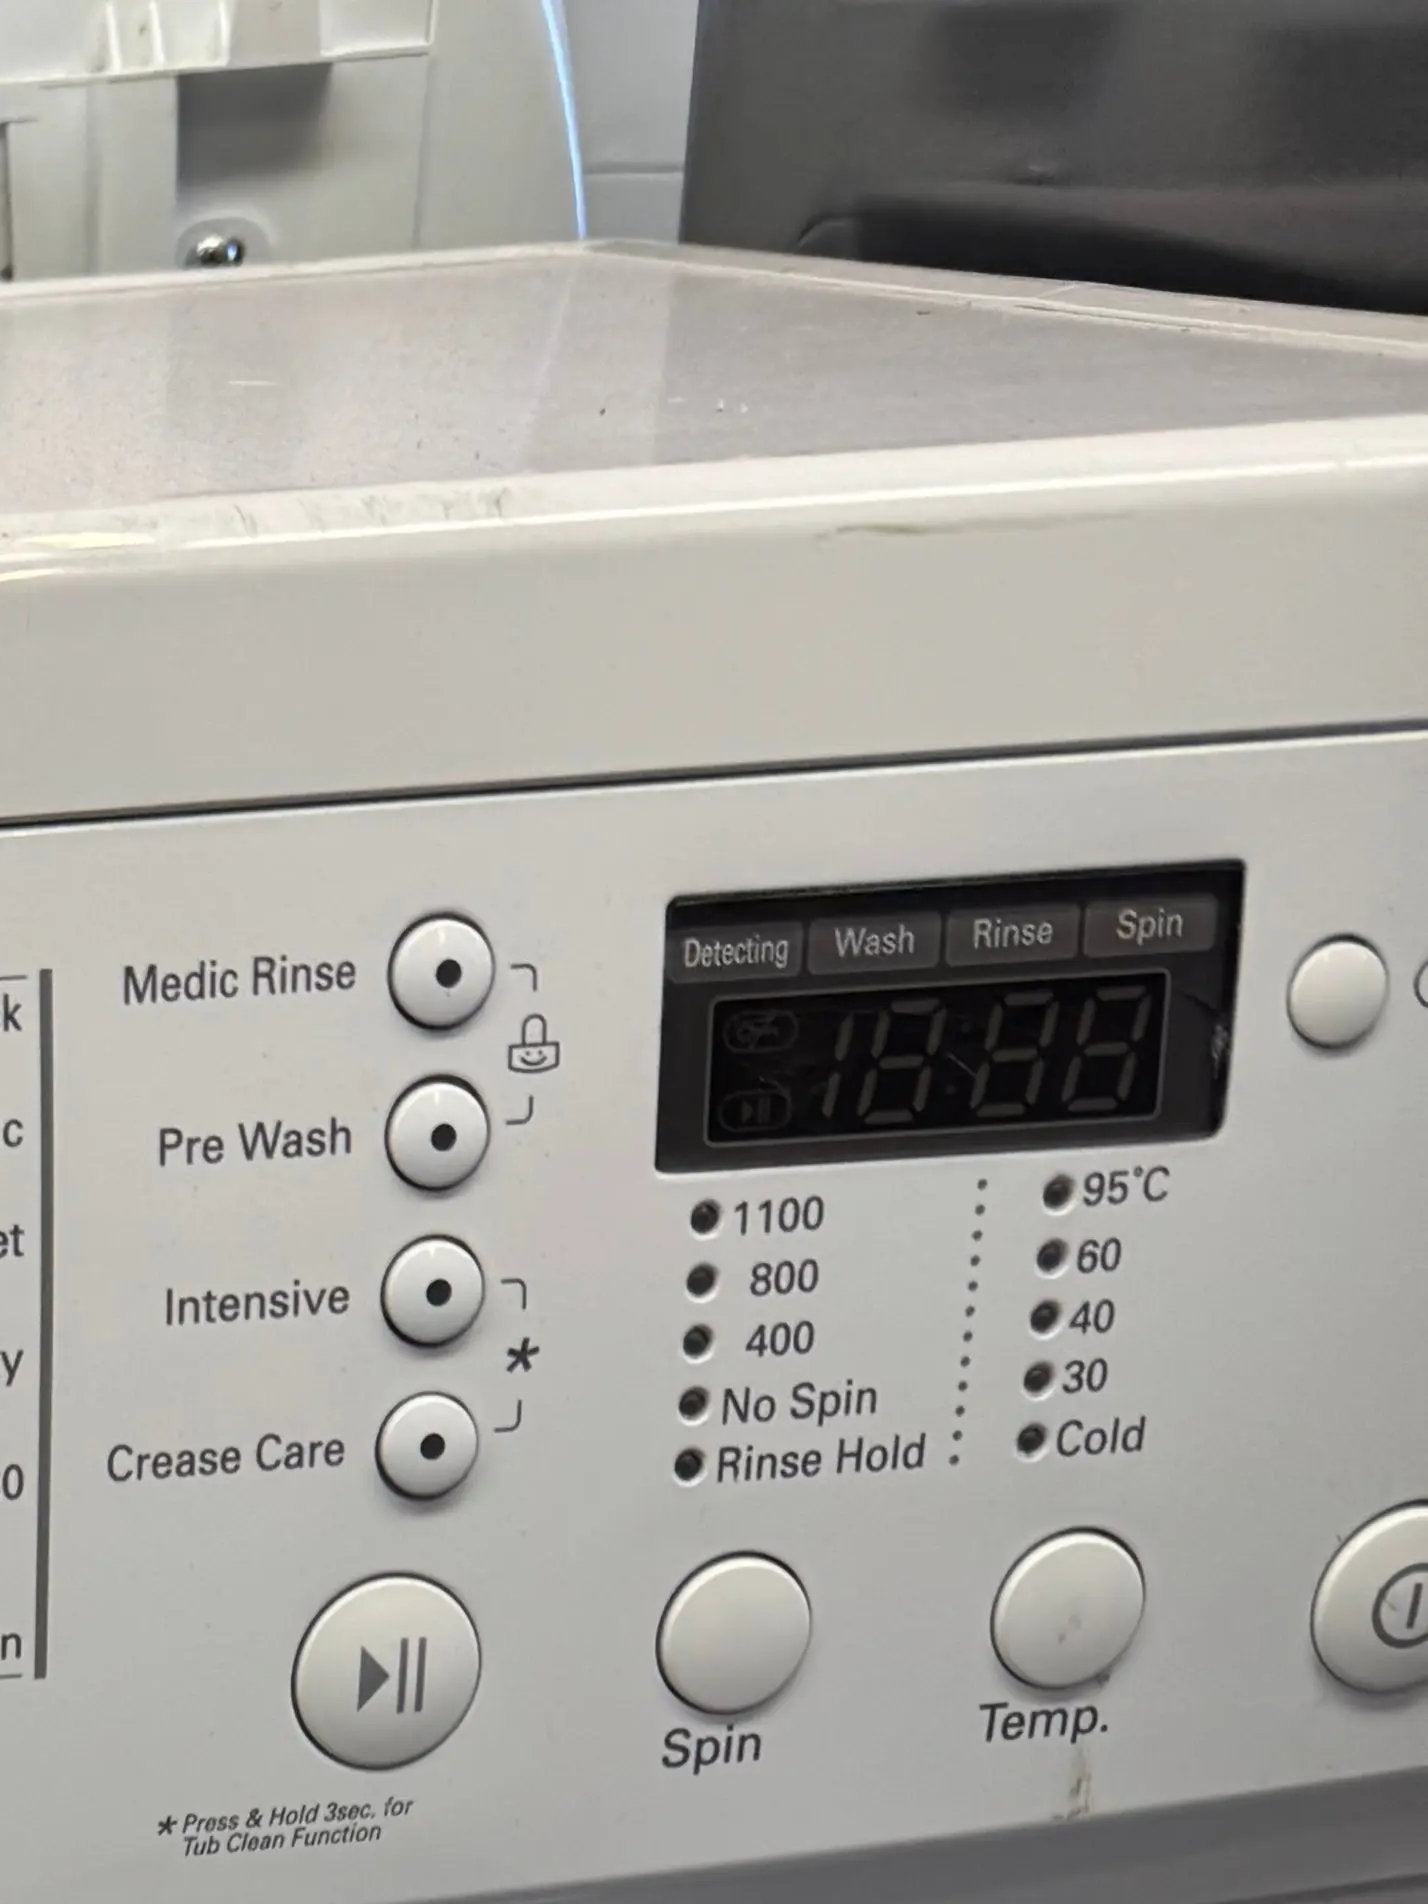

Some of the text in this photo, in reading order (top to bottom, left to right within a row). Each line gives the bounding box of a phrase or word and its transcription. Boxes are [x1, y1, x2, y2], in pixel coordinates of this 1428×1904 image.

[832, 922, 916, 960] Wash
[971, 913, 1054, 952] Rinse
[1114, 904, 1185, 942] Spin
[681, 932, 792, 972] Detecting
[123, 954, 358, 1006] Medic Rinse
[157, 1116, 353, 1168] Pre Wash
[734, 1194, 826, 1236] 1100
[1074, 1235, 1123, 1274] 60
[748, 1257, 820, 1297] 800
[164, 1279, 351, 1326] Intensive
[1068, 1298, 1117, 1336] 40
[744, 1320, 816, 1358] 400
[1061, 1358, 1110, 1396] 30
[720, 1379, 879, 1426] No Spin
[106, 1432, 347, 1484] Crease Care
[1054, 1416, 1147, 1460] Cold
[715, 1434, 928, 1486] Rinse Hold
[976, 1698, 1112, 1744] Temp.
[660, 1724, 764, 1775] Spin
[182, 1795, 416, 1834] Press & Hold 3sec. for
[183, 1822, 383, 1858] Tub Clean Function
